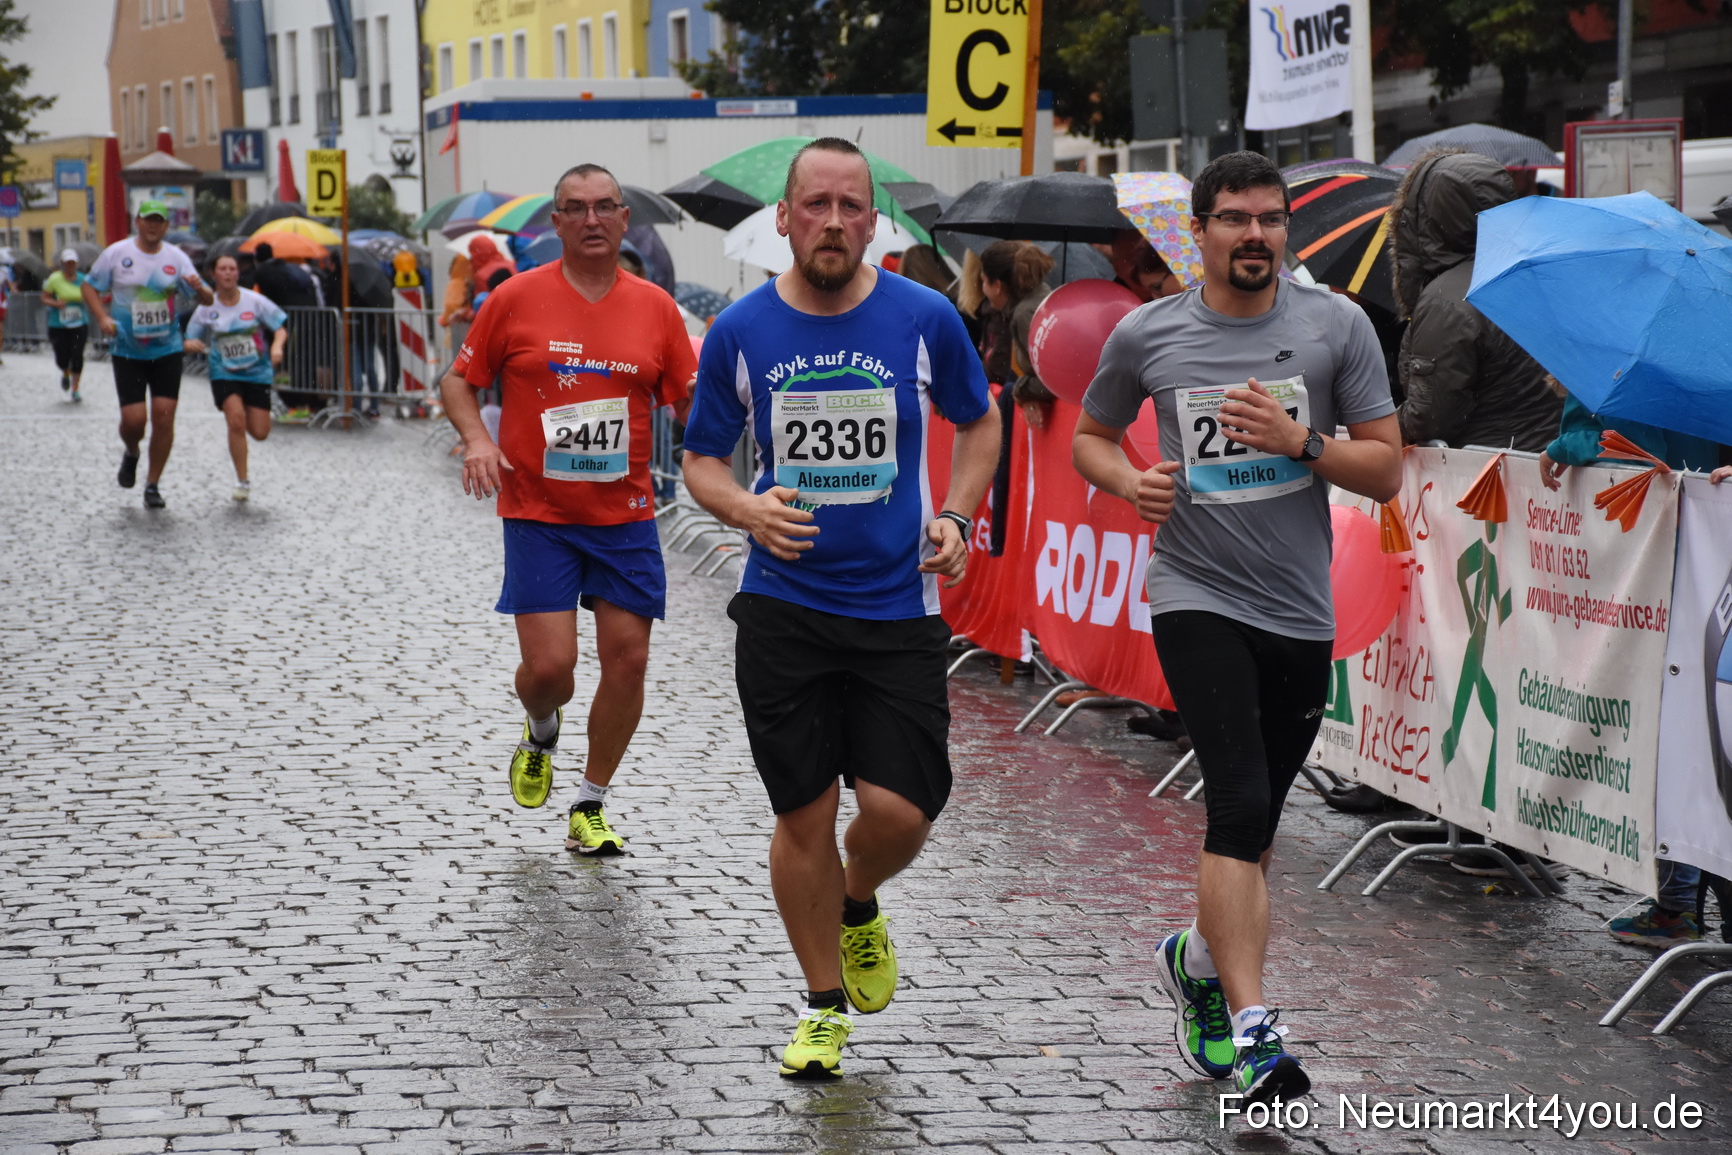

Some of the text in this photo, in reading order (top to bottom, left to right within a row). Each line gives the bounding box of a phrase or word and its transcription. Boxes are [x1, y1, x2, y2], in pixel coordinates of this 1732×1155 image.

[945, 0, 1028, 15] Block
[956, 28, 1011, 111] C
[310, 151, 342, 164] Block
[318, 170, 336, 200] D
[136, 310, 168, 326] 2619
[549, 340, 583, 349] Regensburg
[549, 345, 583, 354] Marathon
[565, 356, 638, 375] 28. Mai 2006
[765, 350, 894, 383] Wyk auf Föhr
[582, 401, 624, 415] BOCK
[781, 404, 819, 412] NeuerMarkt
[826, 393, 886, 409] BOCK
[550, 413, 578, 422] NeuerMarkt
[555, 419, 624, 450] 2447
[786, 417, 887, 461] 2336
[571, 458, 609, 471] Lothar
[1190, 457, 1196, 465] D
[797, 471, 878, 489] Alexander
[1227, 465, 1276, 486] Heiko
[1527, 498, 1583, 537] Service-Line:
[1576, 549, 1591, 580] 52
[1518, 667, 1631, 743] Gebäudereinigung
[1359, 704, 1431, 784] BESSER
[1516, 727, 1631, 793] Hausmeisterdienst
[1517, 786, 1640, 862] Arbeitsbühnenverleih
